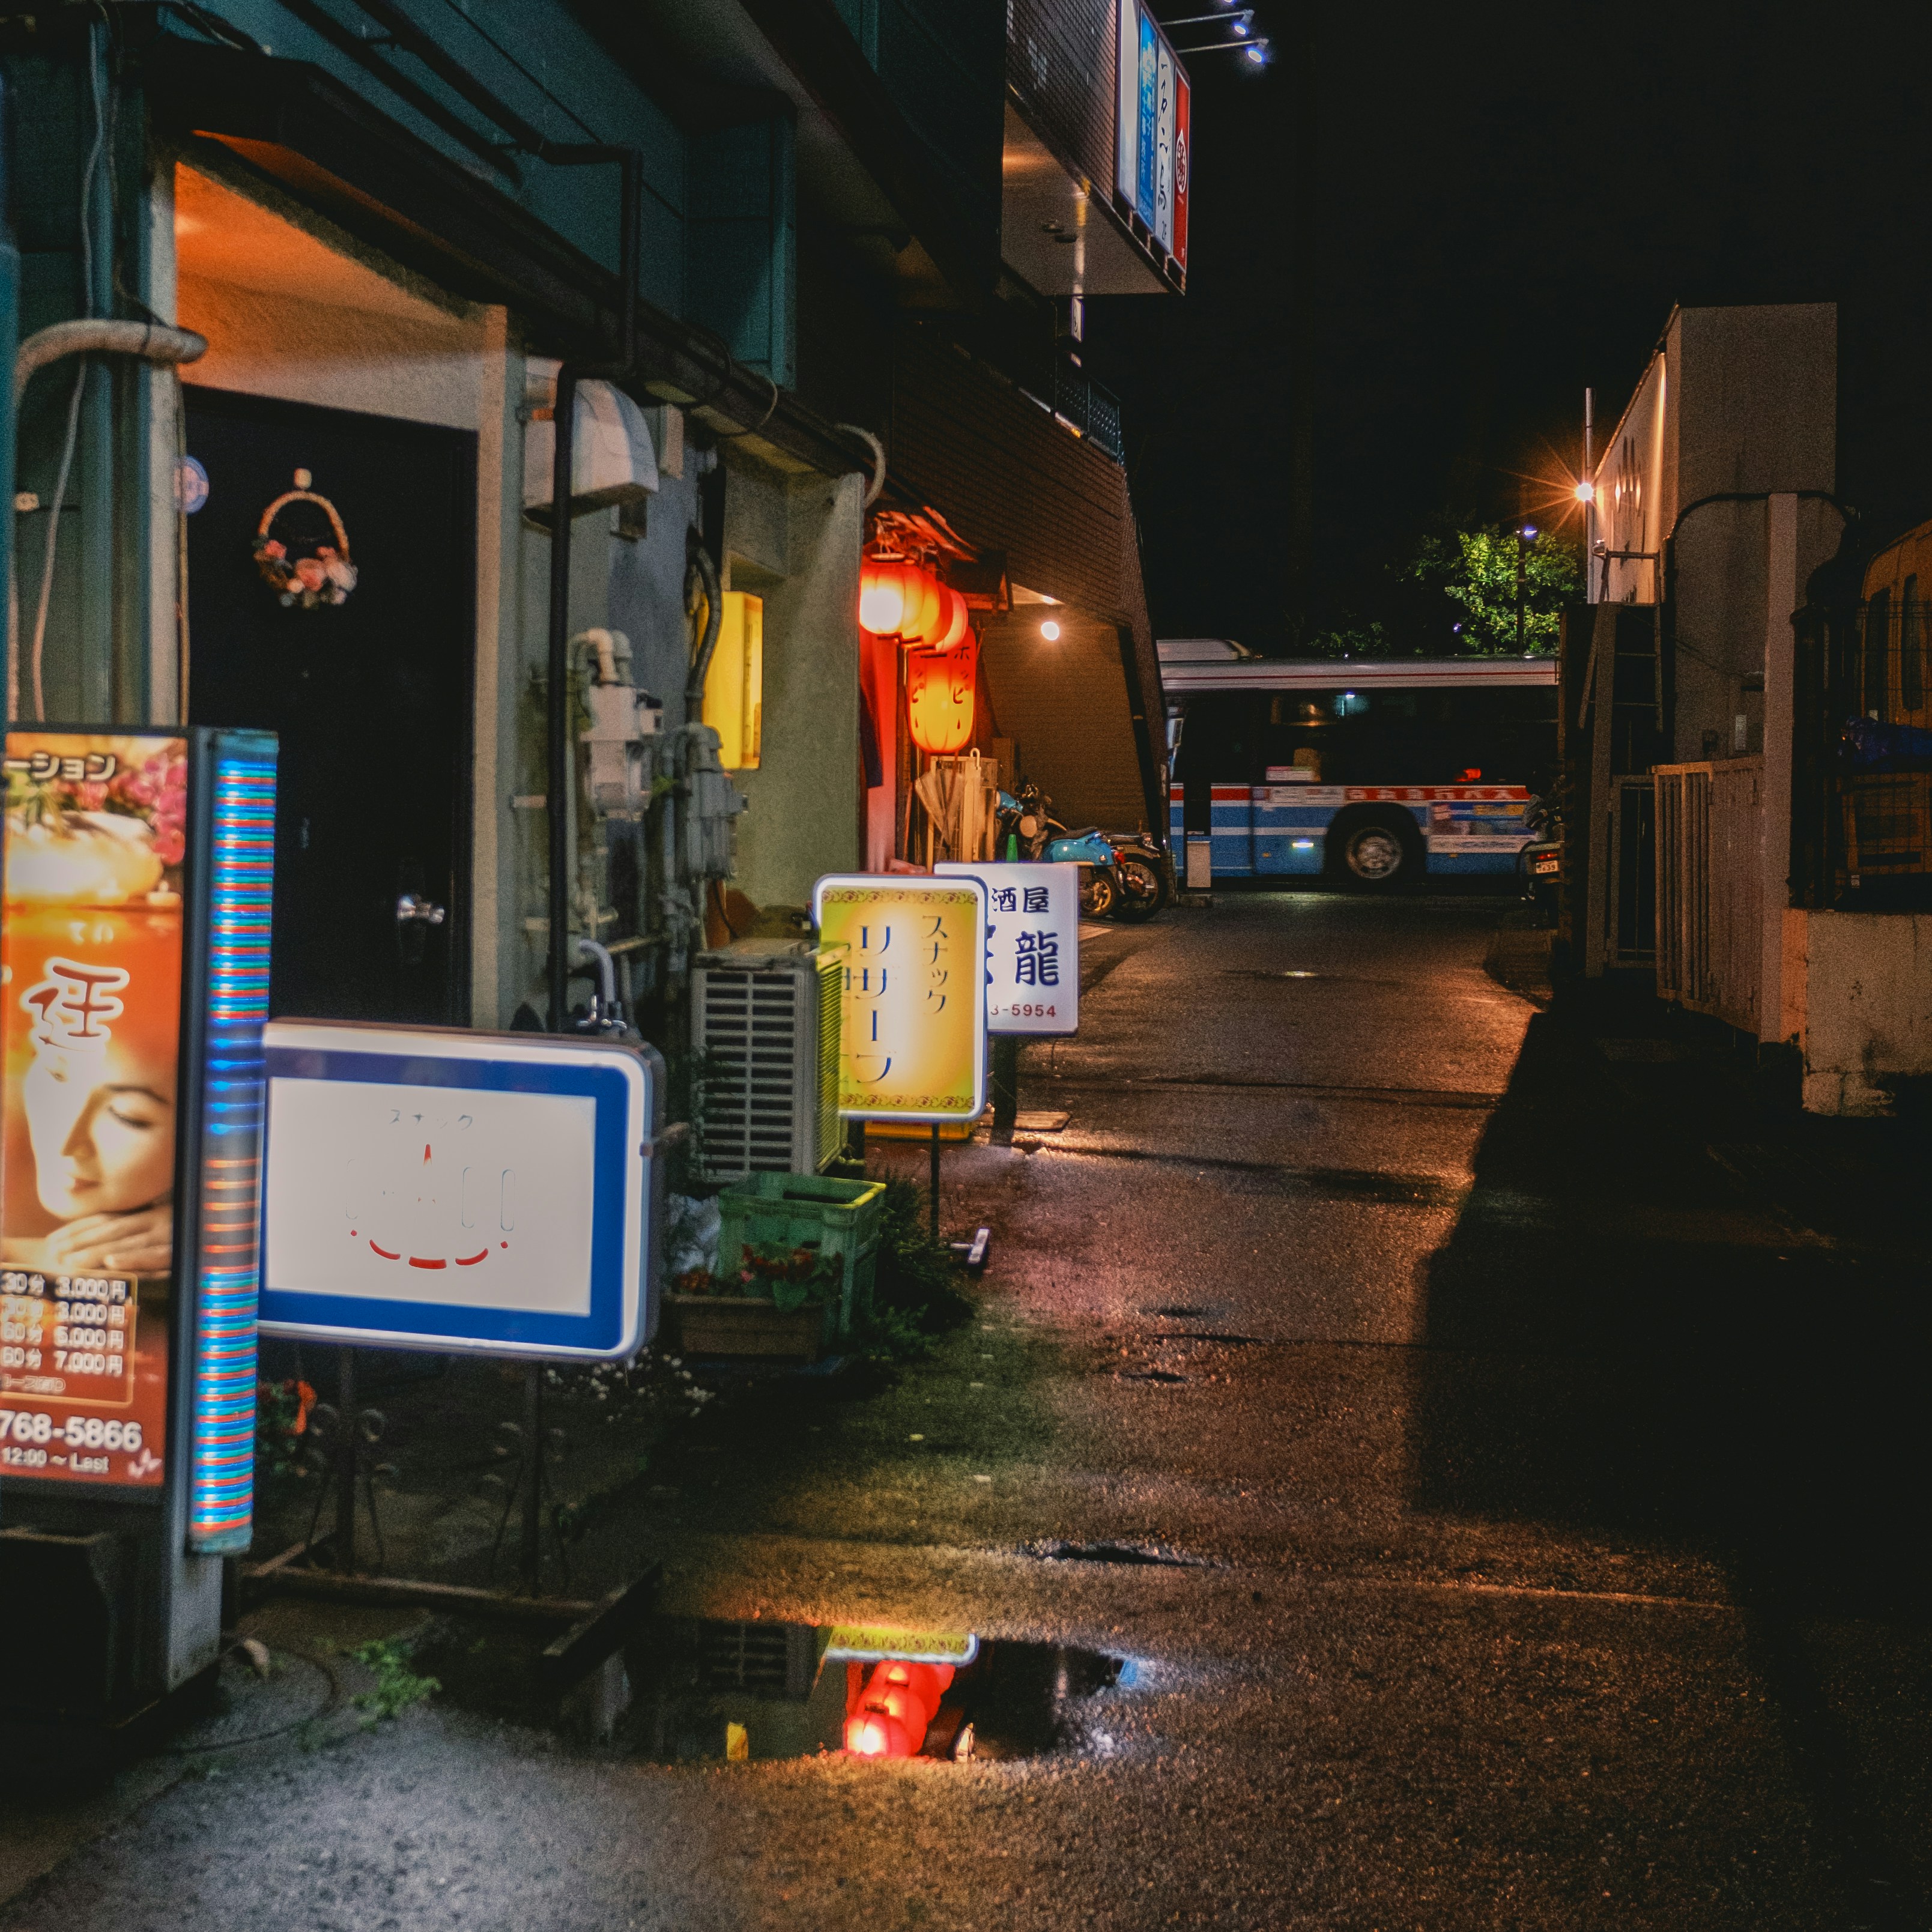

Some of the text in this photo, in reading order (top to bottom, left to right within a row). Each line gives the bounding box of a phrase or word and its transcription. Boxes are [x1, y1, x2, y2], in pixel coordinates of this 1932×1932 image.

[921, 914, 949, 1015] スナック
[987, 924, 1059, 986] 龍
[990, 1004, 1057, 1018] 3-5954
